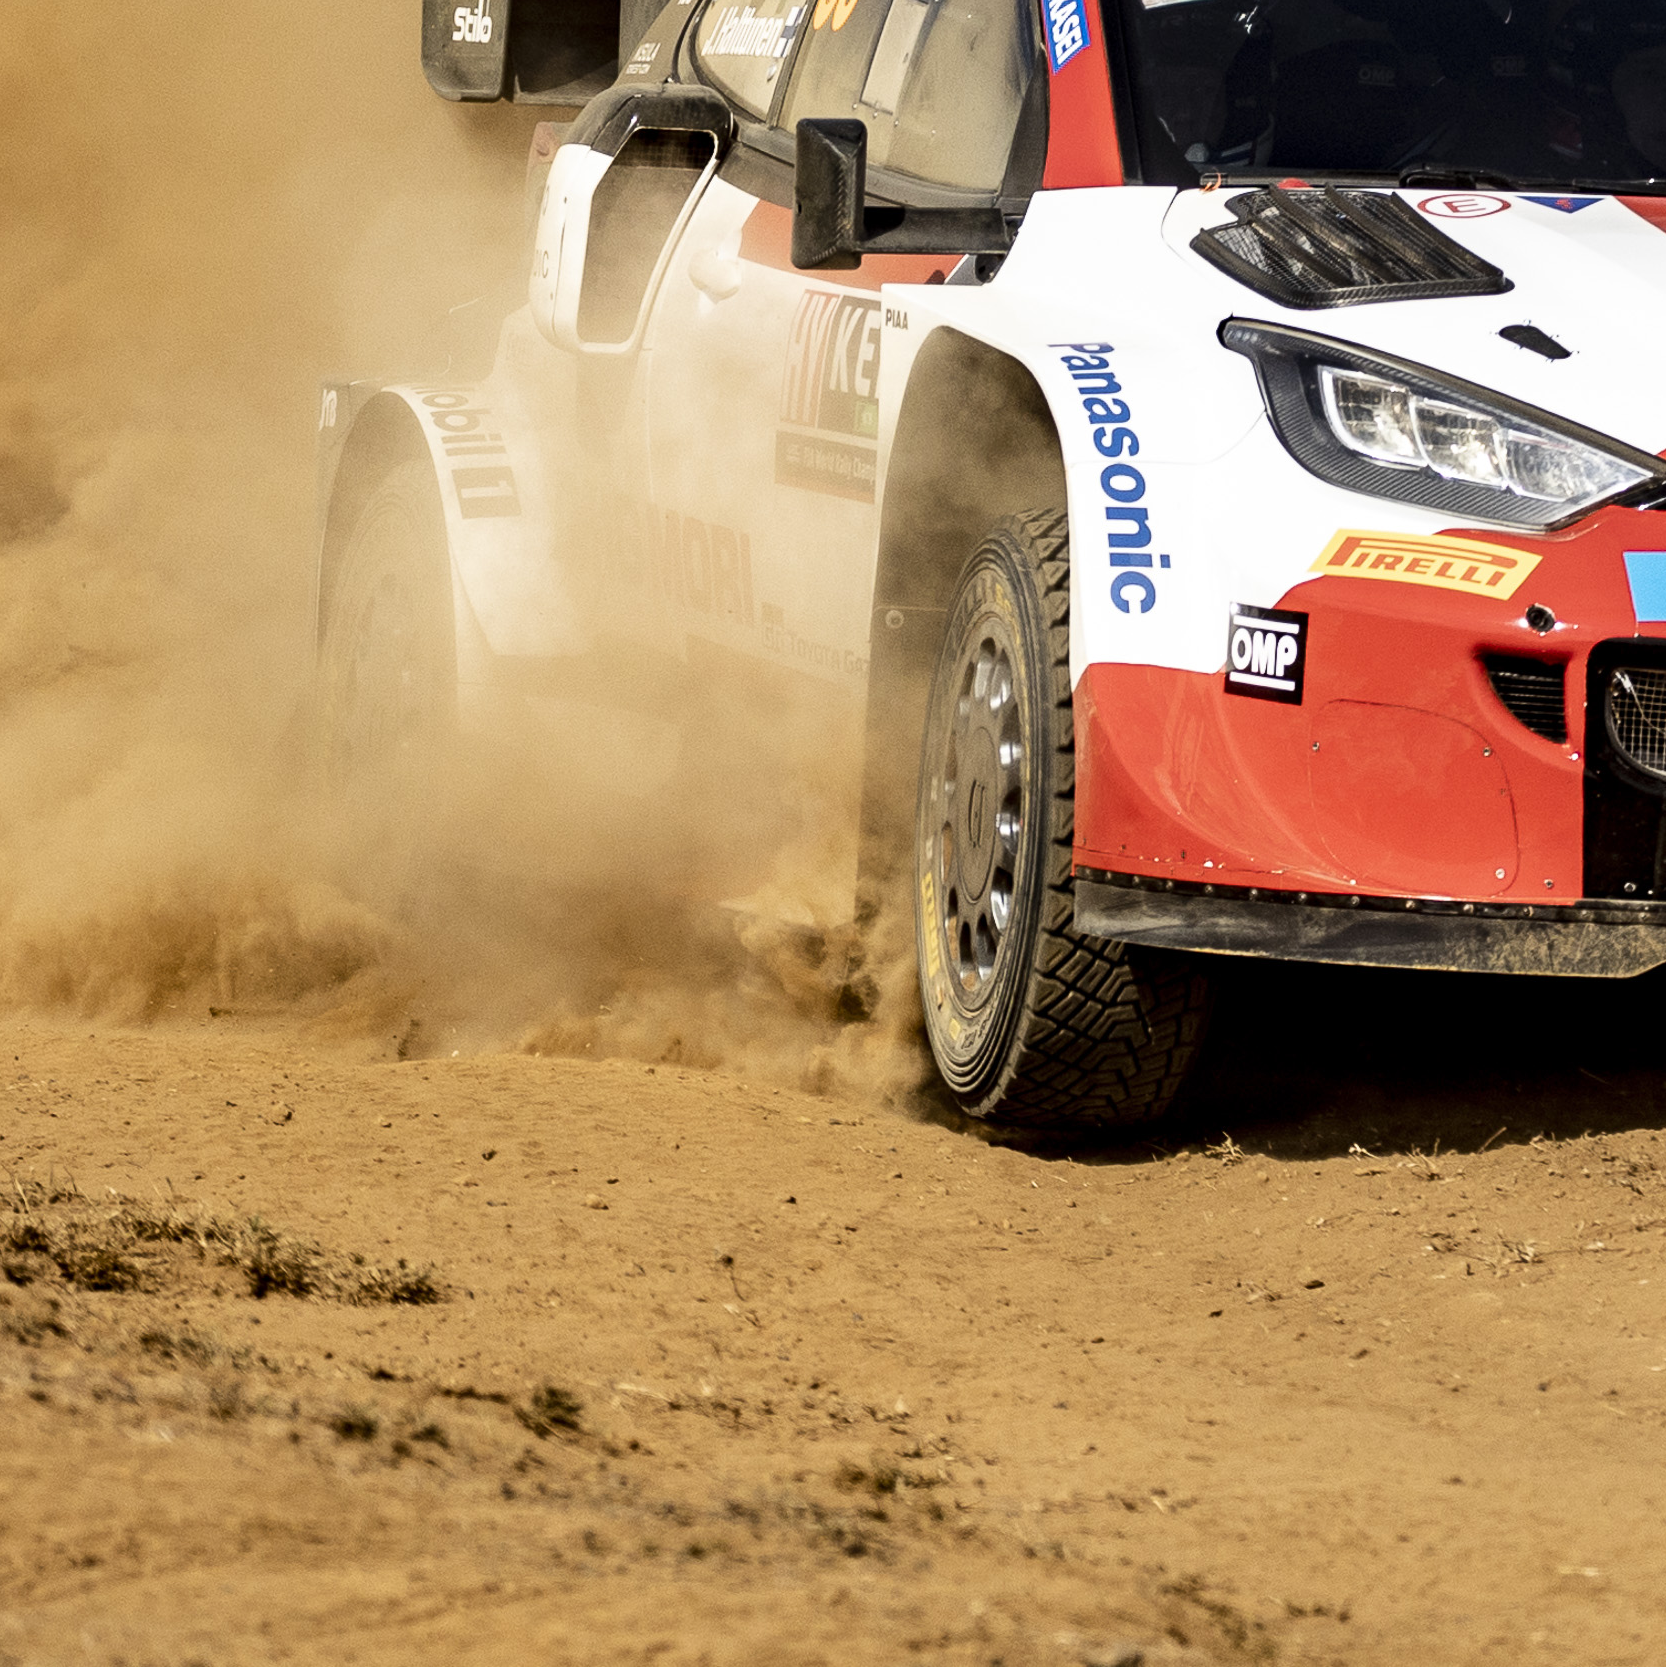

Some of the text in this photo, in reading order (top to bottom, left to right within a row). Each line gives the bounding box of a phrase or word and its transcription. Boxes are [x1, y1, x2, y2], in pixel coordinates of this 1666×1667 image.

[885, 308, 909, 330] PIAA
[1047, 342, 1171, 614] Panasonic
[1326, 536, 1517, 588] PIRELLI
[1231, 627, 1299, 677] OMP
